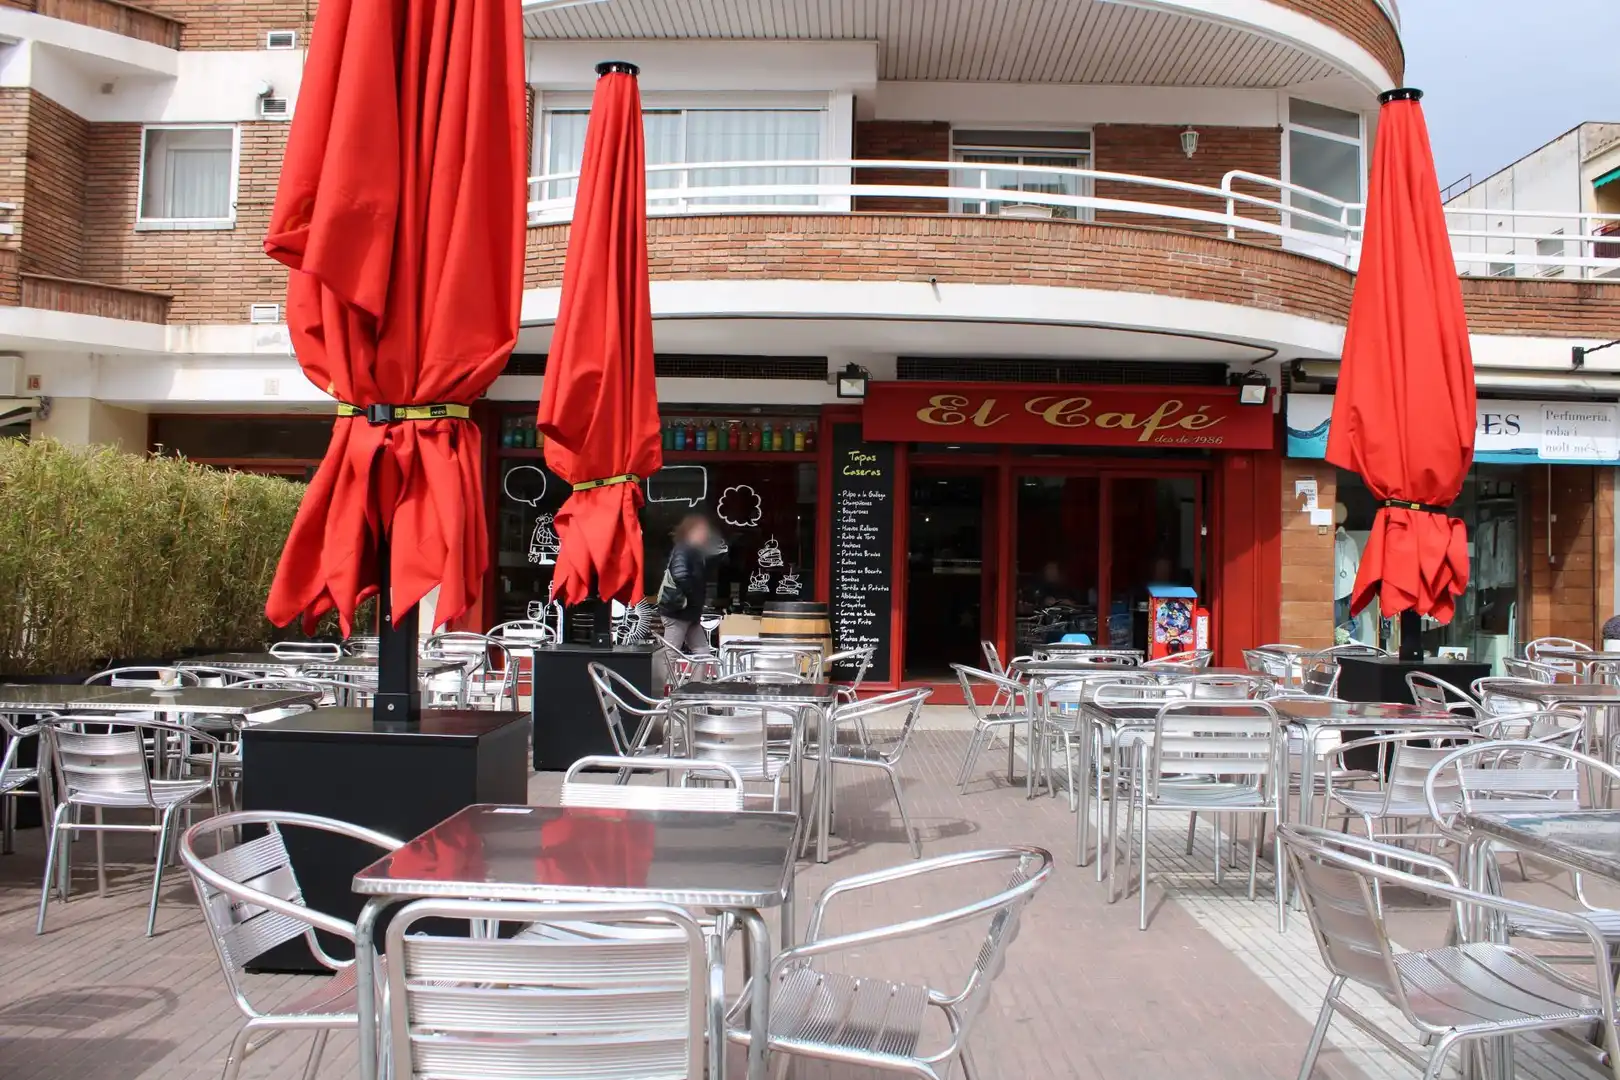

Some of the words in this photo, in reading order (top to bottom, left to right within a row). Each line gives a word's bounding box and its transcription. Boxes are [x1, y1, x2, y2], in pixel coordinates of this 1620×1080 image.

[916, 394, 1009, 427] El
[1024, 396, 1227, 442] Café
[1475, 413, 1521, 436] ES
[1545, 425, 1570, 437] roba
[1574, 426, 1578, 437] i
[1194, 435, 1224, 445] 1986
[1545, 441, 1569, 453] molt
[848, 450, 877, 466] Tapas
[843, 465, 881, 476] Caseras
[842, 489, 856, 500] Pulpo
[862, 490, 867, 498] la
[841, 532, 855, 540] Rabo
[856, 532, 863, 540] de
[863, 532, 876, 540] Toro
[841, 549, 863, 557] Patatas
[863, 549, 881, 557] Bravas
[867, 583, 890, 591] Patatas
[840, 601, 867, 611] Croquetas
[840, 609, 855, 617] Carne
[863, 609, 876, 617] Salsa
[839, 617, 857, 625] Morro
[857, 617, 872, 625] Frito
